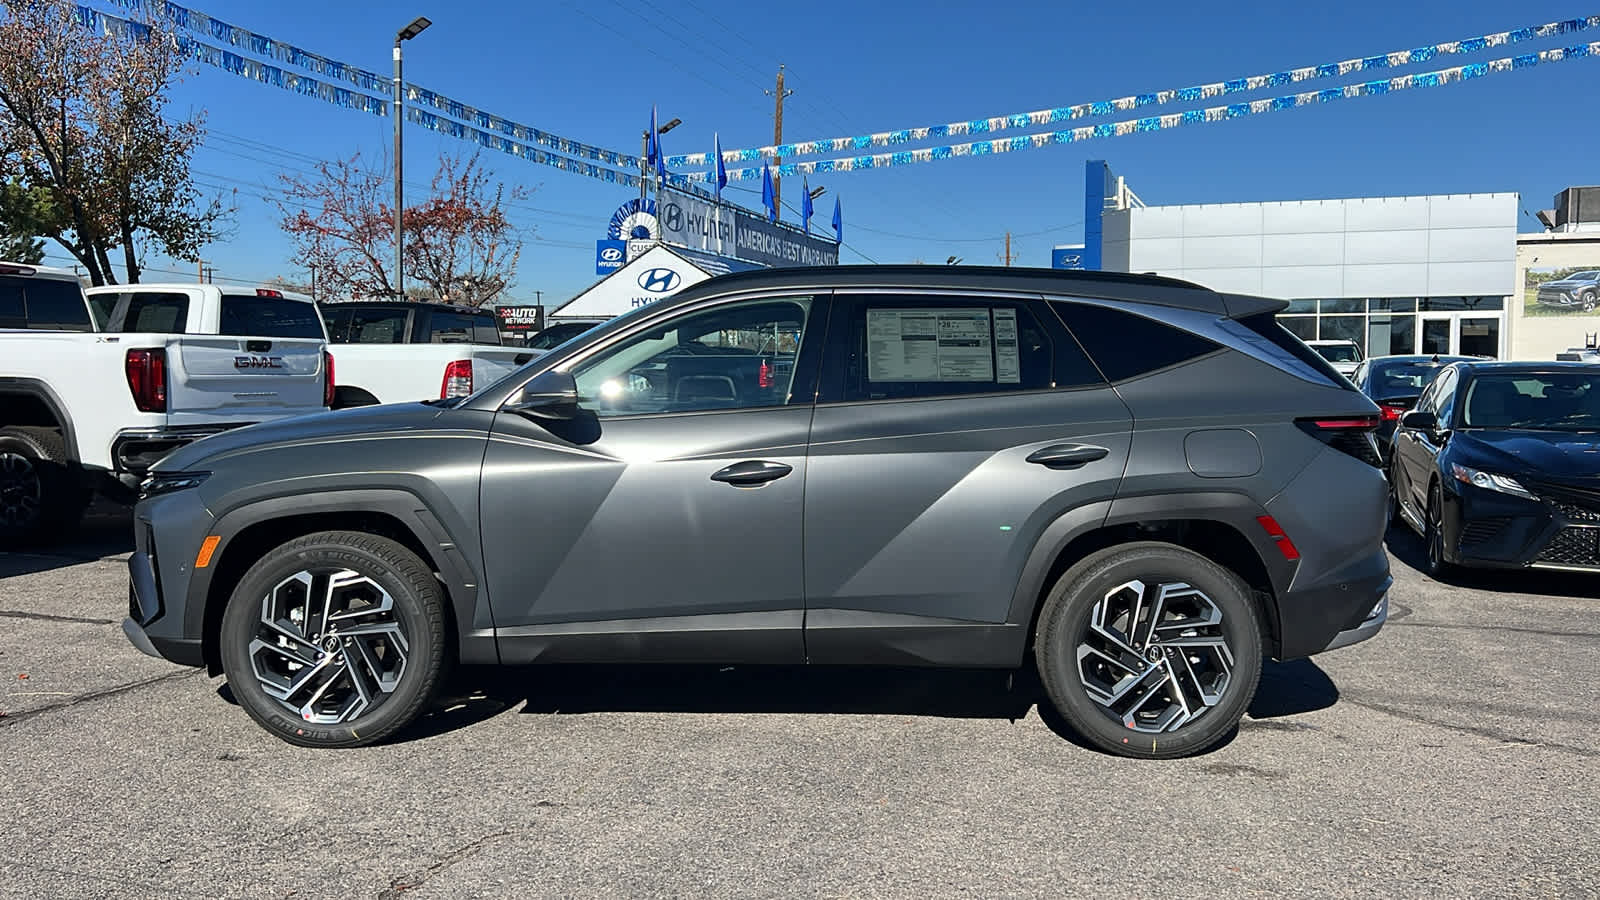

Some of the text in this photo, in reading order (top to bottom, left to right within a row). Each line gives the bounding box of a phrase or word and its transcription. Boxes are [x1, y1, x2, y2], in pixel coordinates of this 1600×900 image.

[737, 228, 837, 266] AMERICA'S BEST WARRANTY
[511, 308, 537, 318] AUTO
[234, 356, 282, 369] GMC
